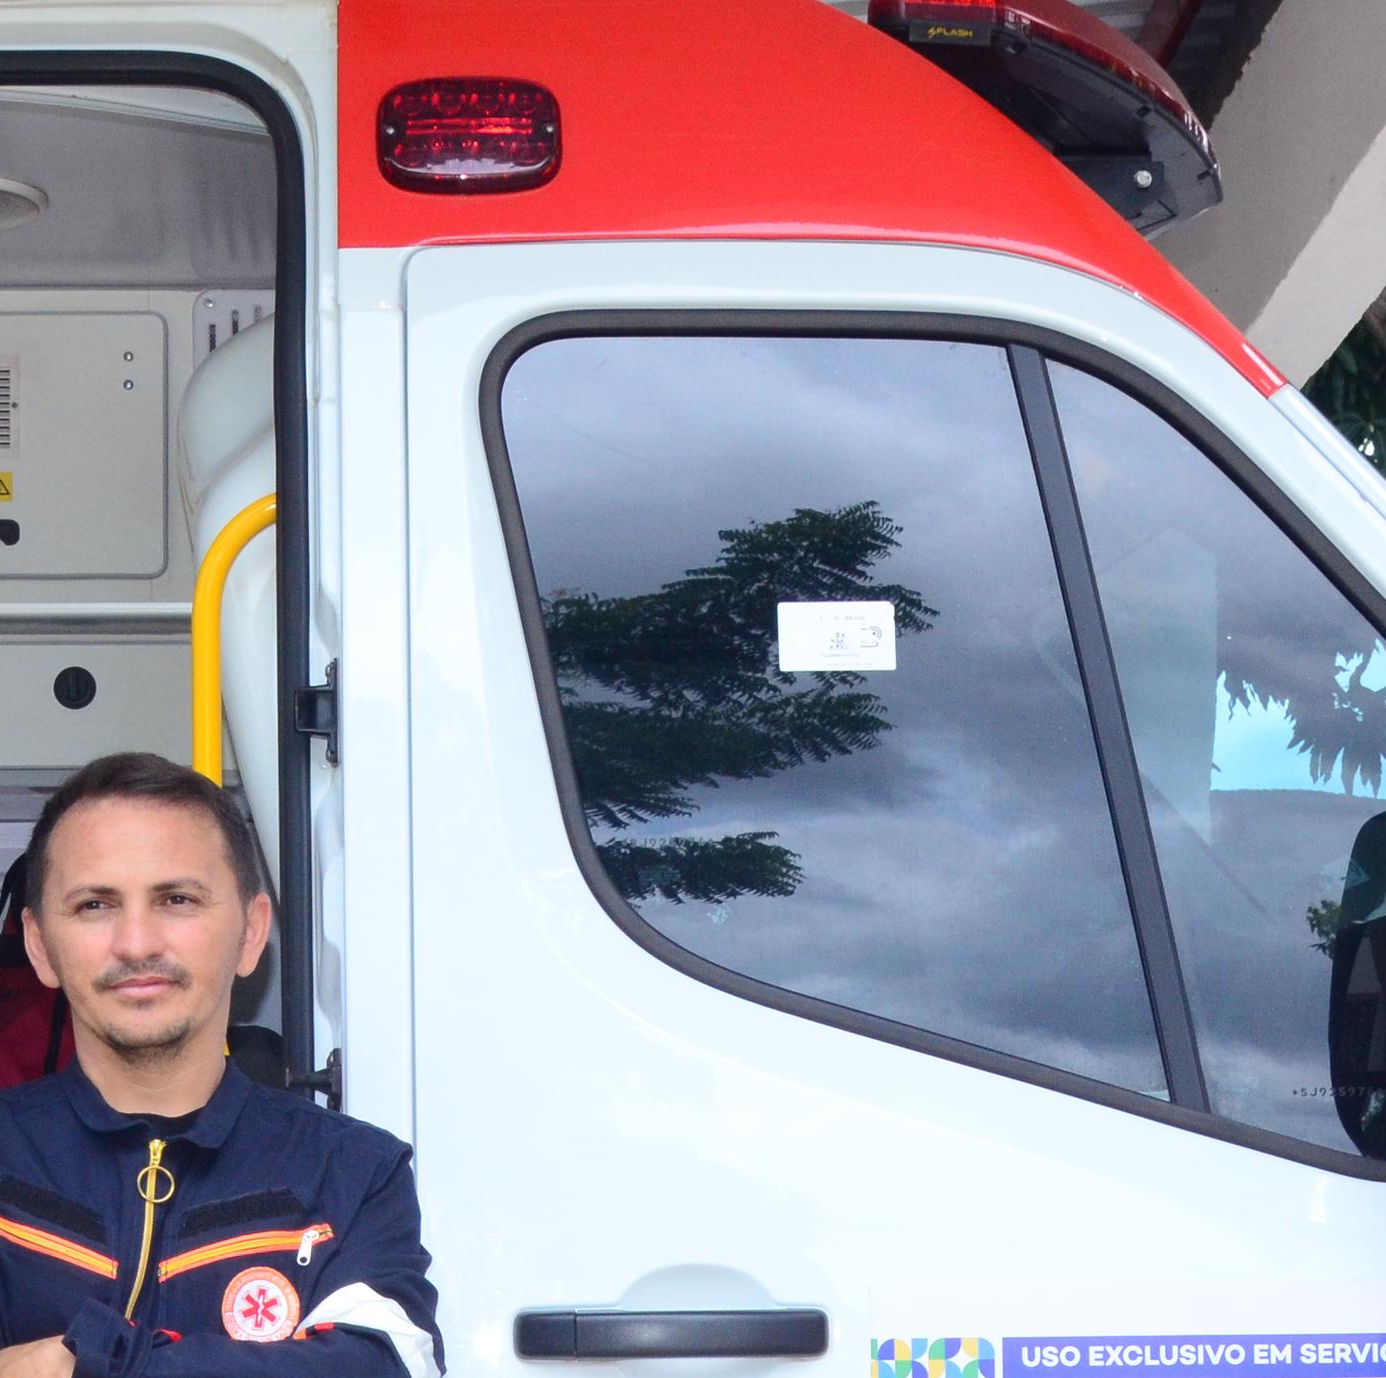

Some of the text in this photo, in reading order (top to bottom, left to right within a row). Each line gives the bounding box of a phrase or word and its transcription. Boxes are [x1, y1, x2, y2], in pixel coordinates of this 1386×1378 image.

[1021, 1345, 1081, 1368] USO
[1088, 1343, 1246, 1367] EXCLUSIVO
[1253, 1343, 1292, 1365] EM
